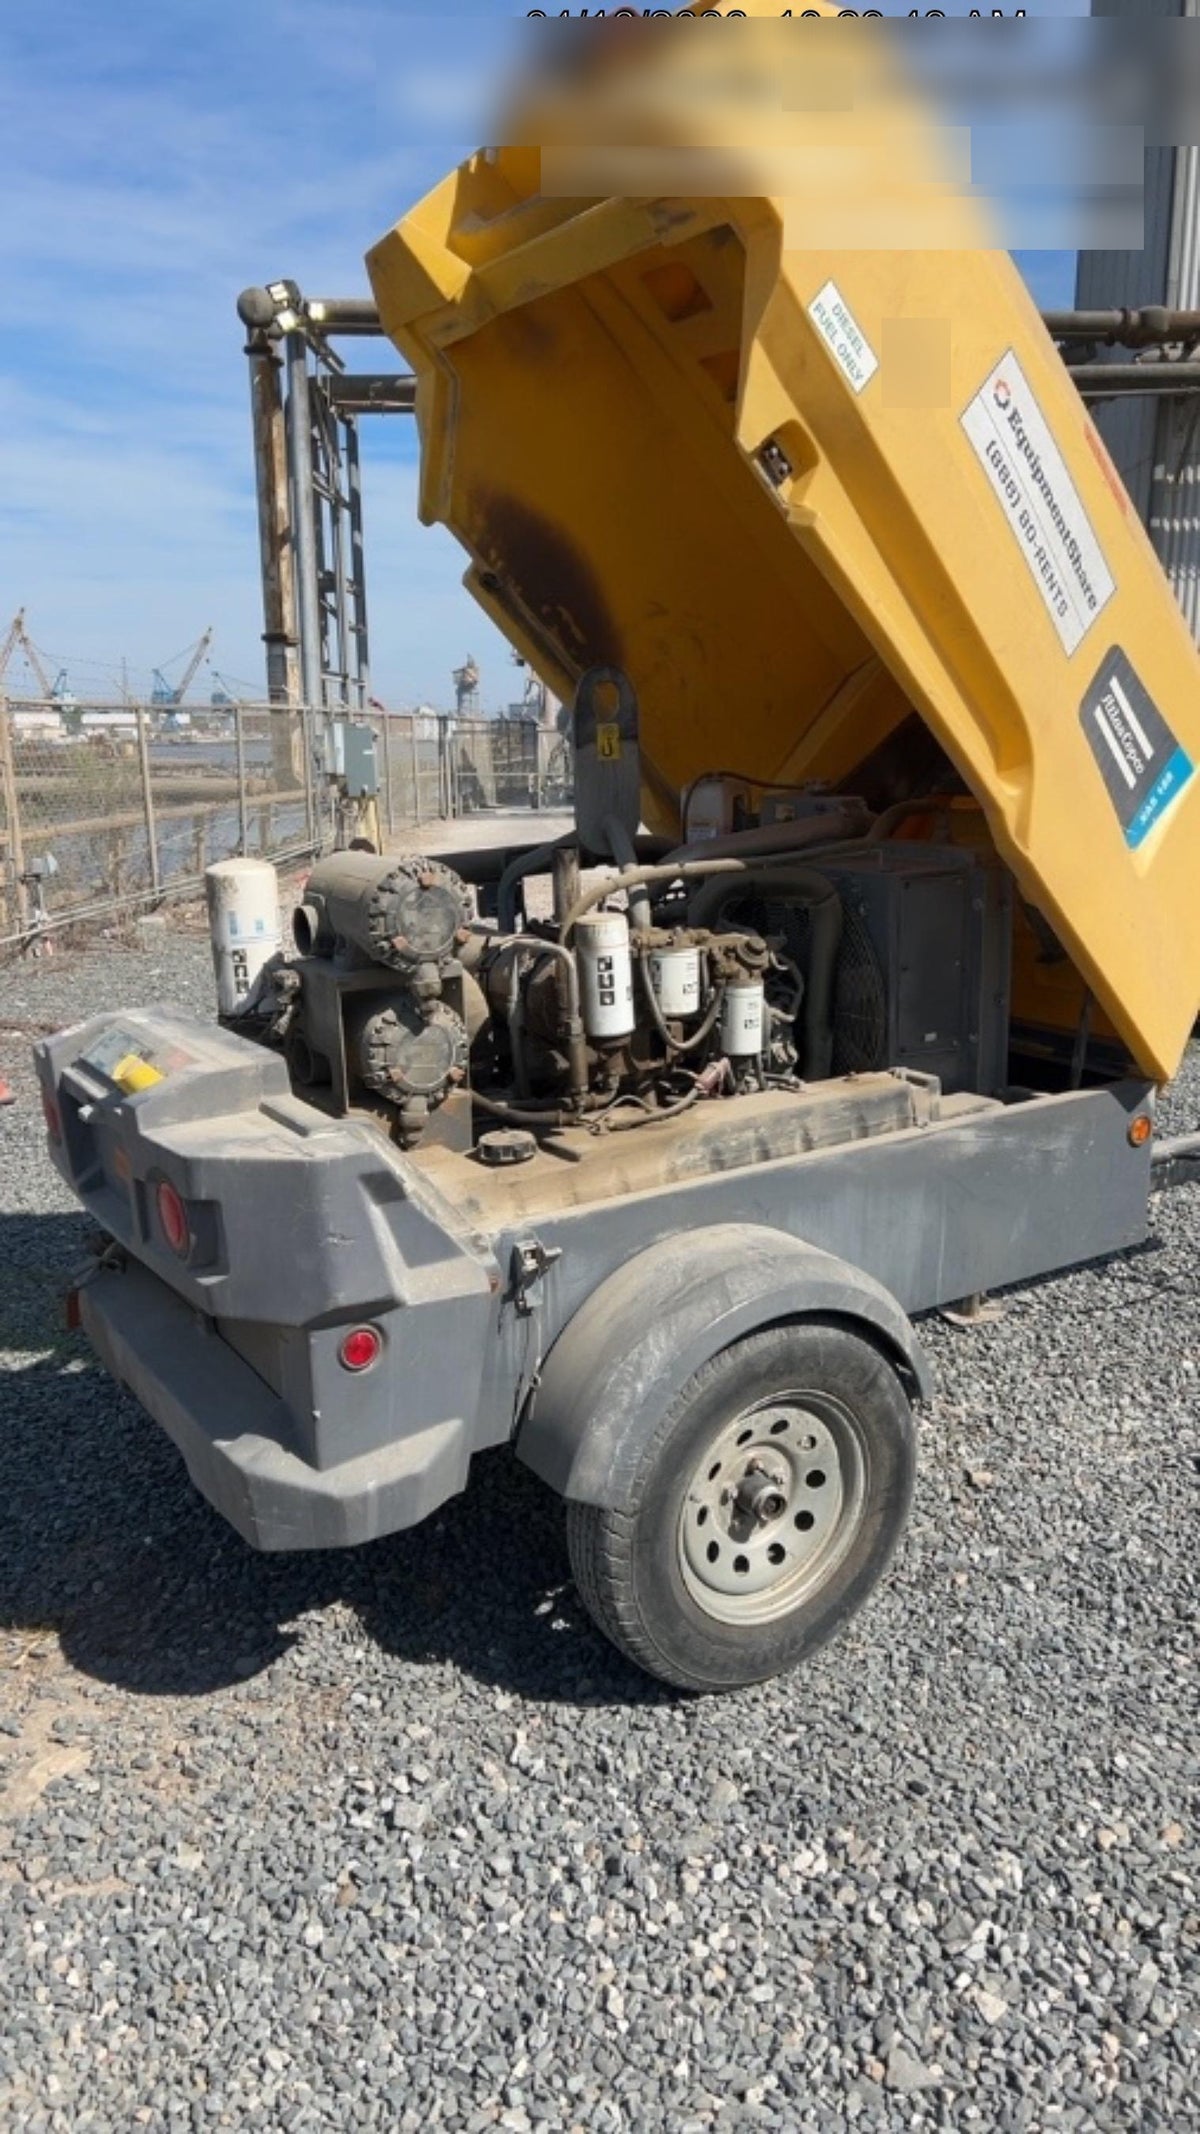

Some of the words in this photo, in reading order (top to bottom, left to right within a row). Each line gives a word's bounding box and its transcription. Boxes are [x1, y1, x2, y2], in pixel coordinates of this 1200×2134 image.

[814, 304, 839, 344] FUEL
[837, 344, 864, 380] ONLY
[832, 304, 864, 358] DIESEL
[1007, 409, 1098, 610] EquipmentShare
